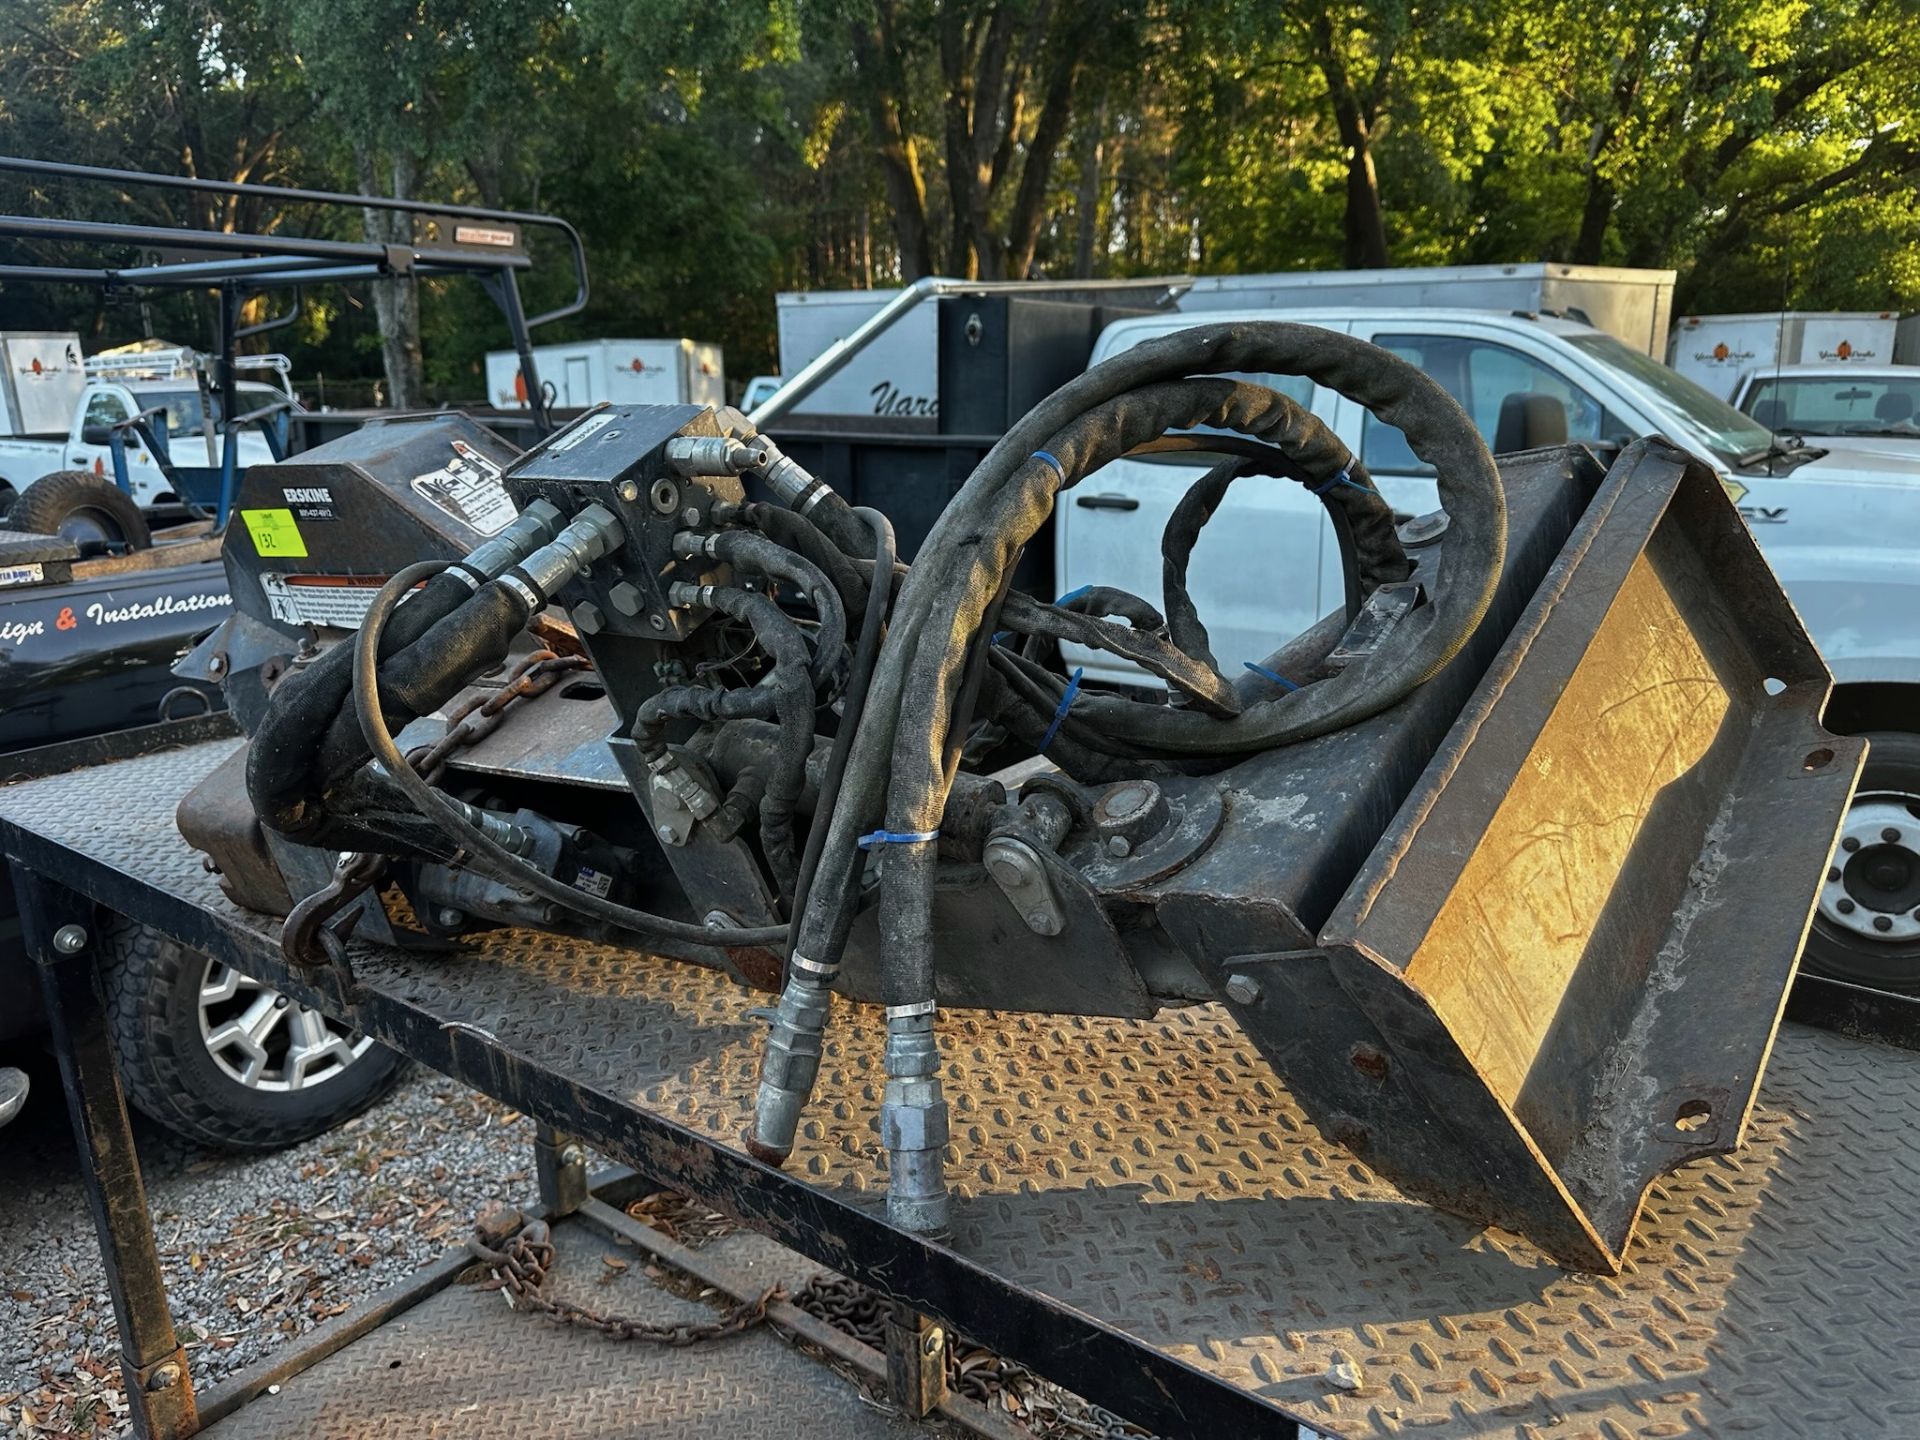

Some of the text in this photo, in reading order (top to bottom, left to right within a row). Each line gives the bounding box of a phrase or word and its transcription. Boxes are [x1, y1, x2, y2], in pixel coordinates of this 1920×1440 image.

[282, 487, 333, 503] ERSKINE
[257, 532, 277, 549] 132
[55, 607, 78, 631] &
[86, 593, 234, 626] Installation
